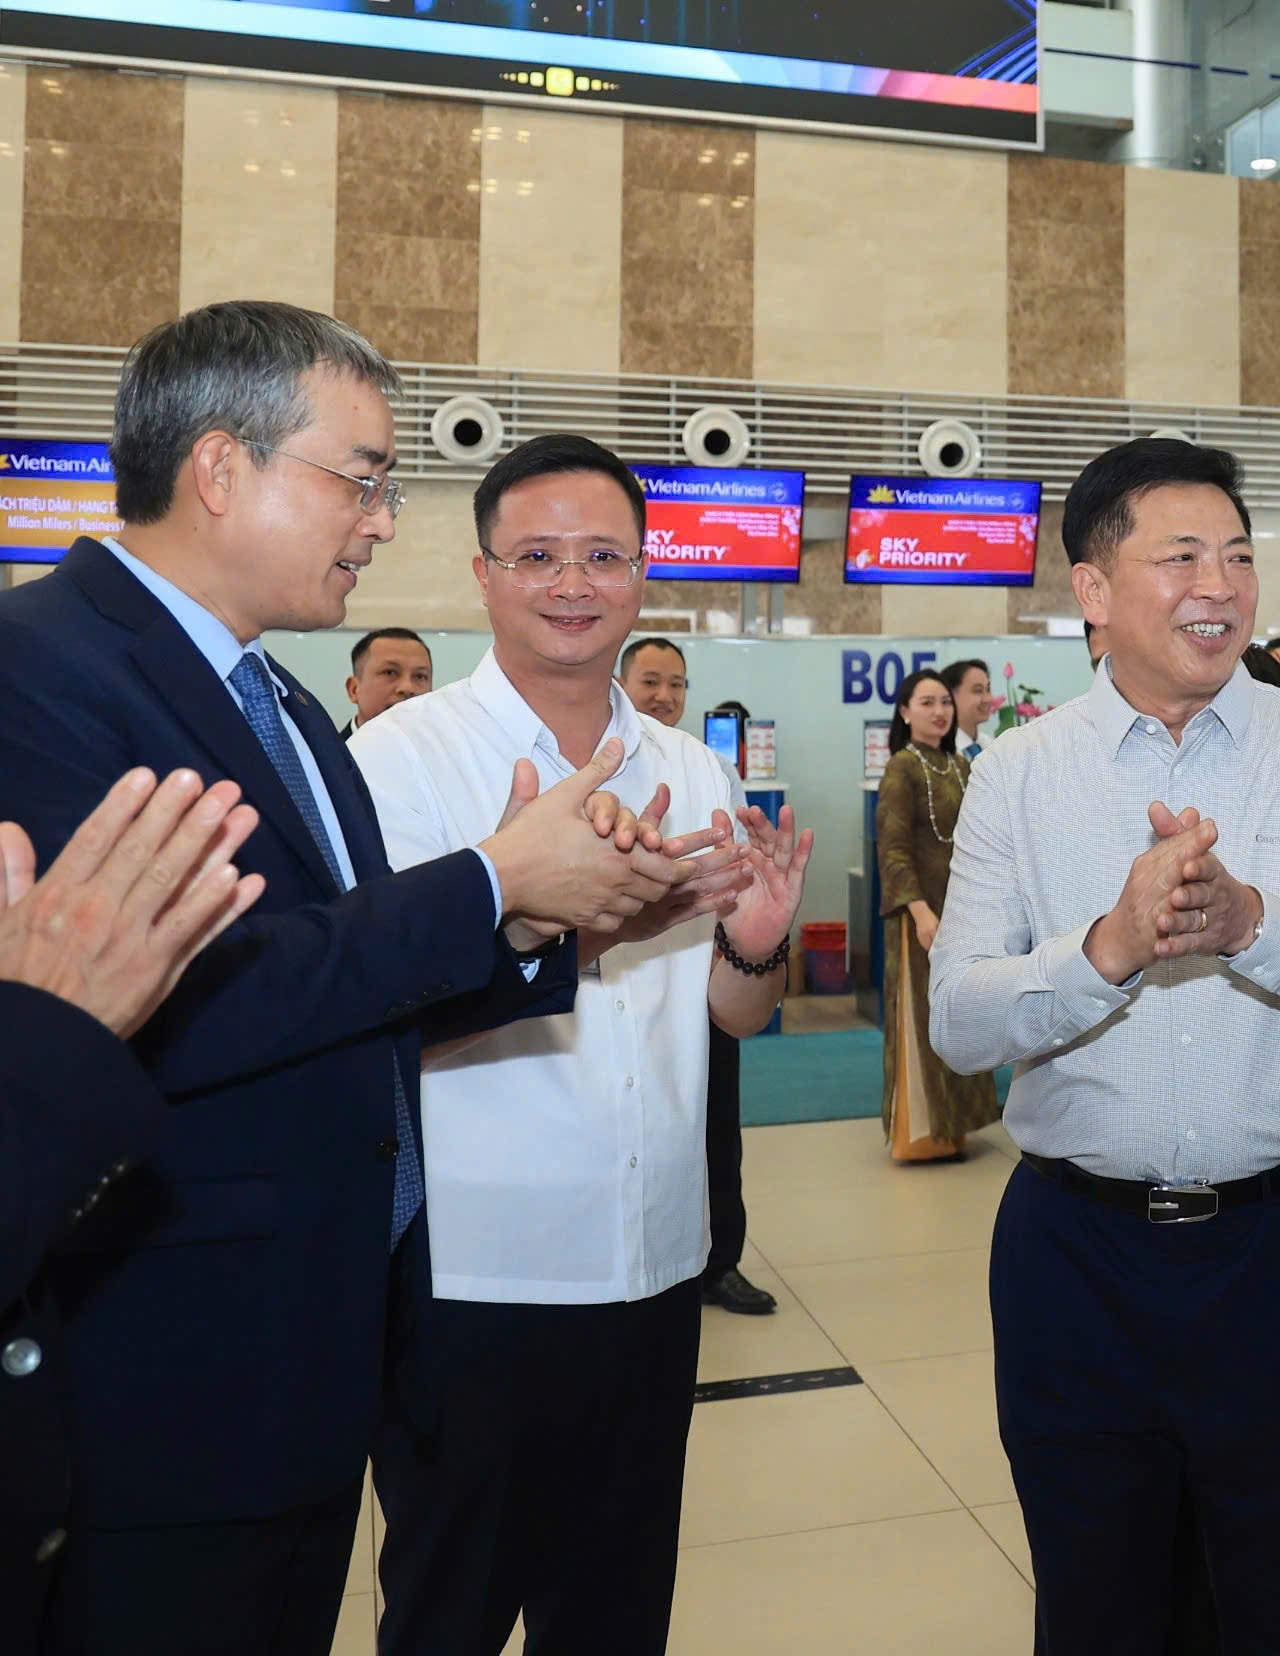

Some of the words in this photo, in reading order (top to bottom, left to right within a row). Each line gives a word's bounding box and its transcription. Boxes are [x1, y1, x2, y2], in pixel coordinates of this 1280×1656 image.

[646, 530, 674, 545] KY
[880, 537, 919, 552] SKY
[643, 544, 727, 560] RIORITY
[879, 551, 967, 567] PRIORITY
